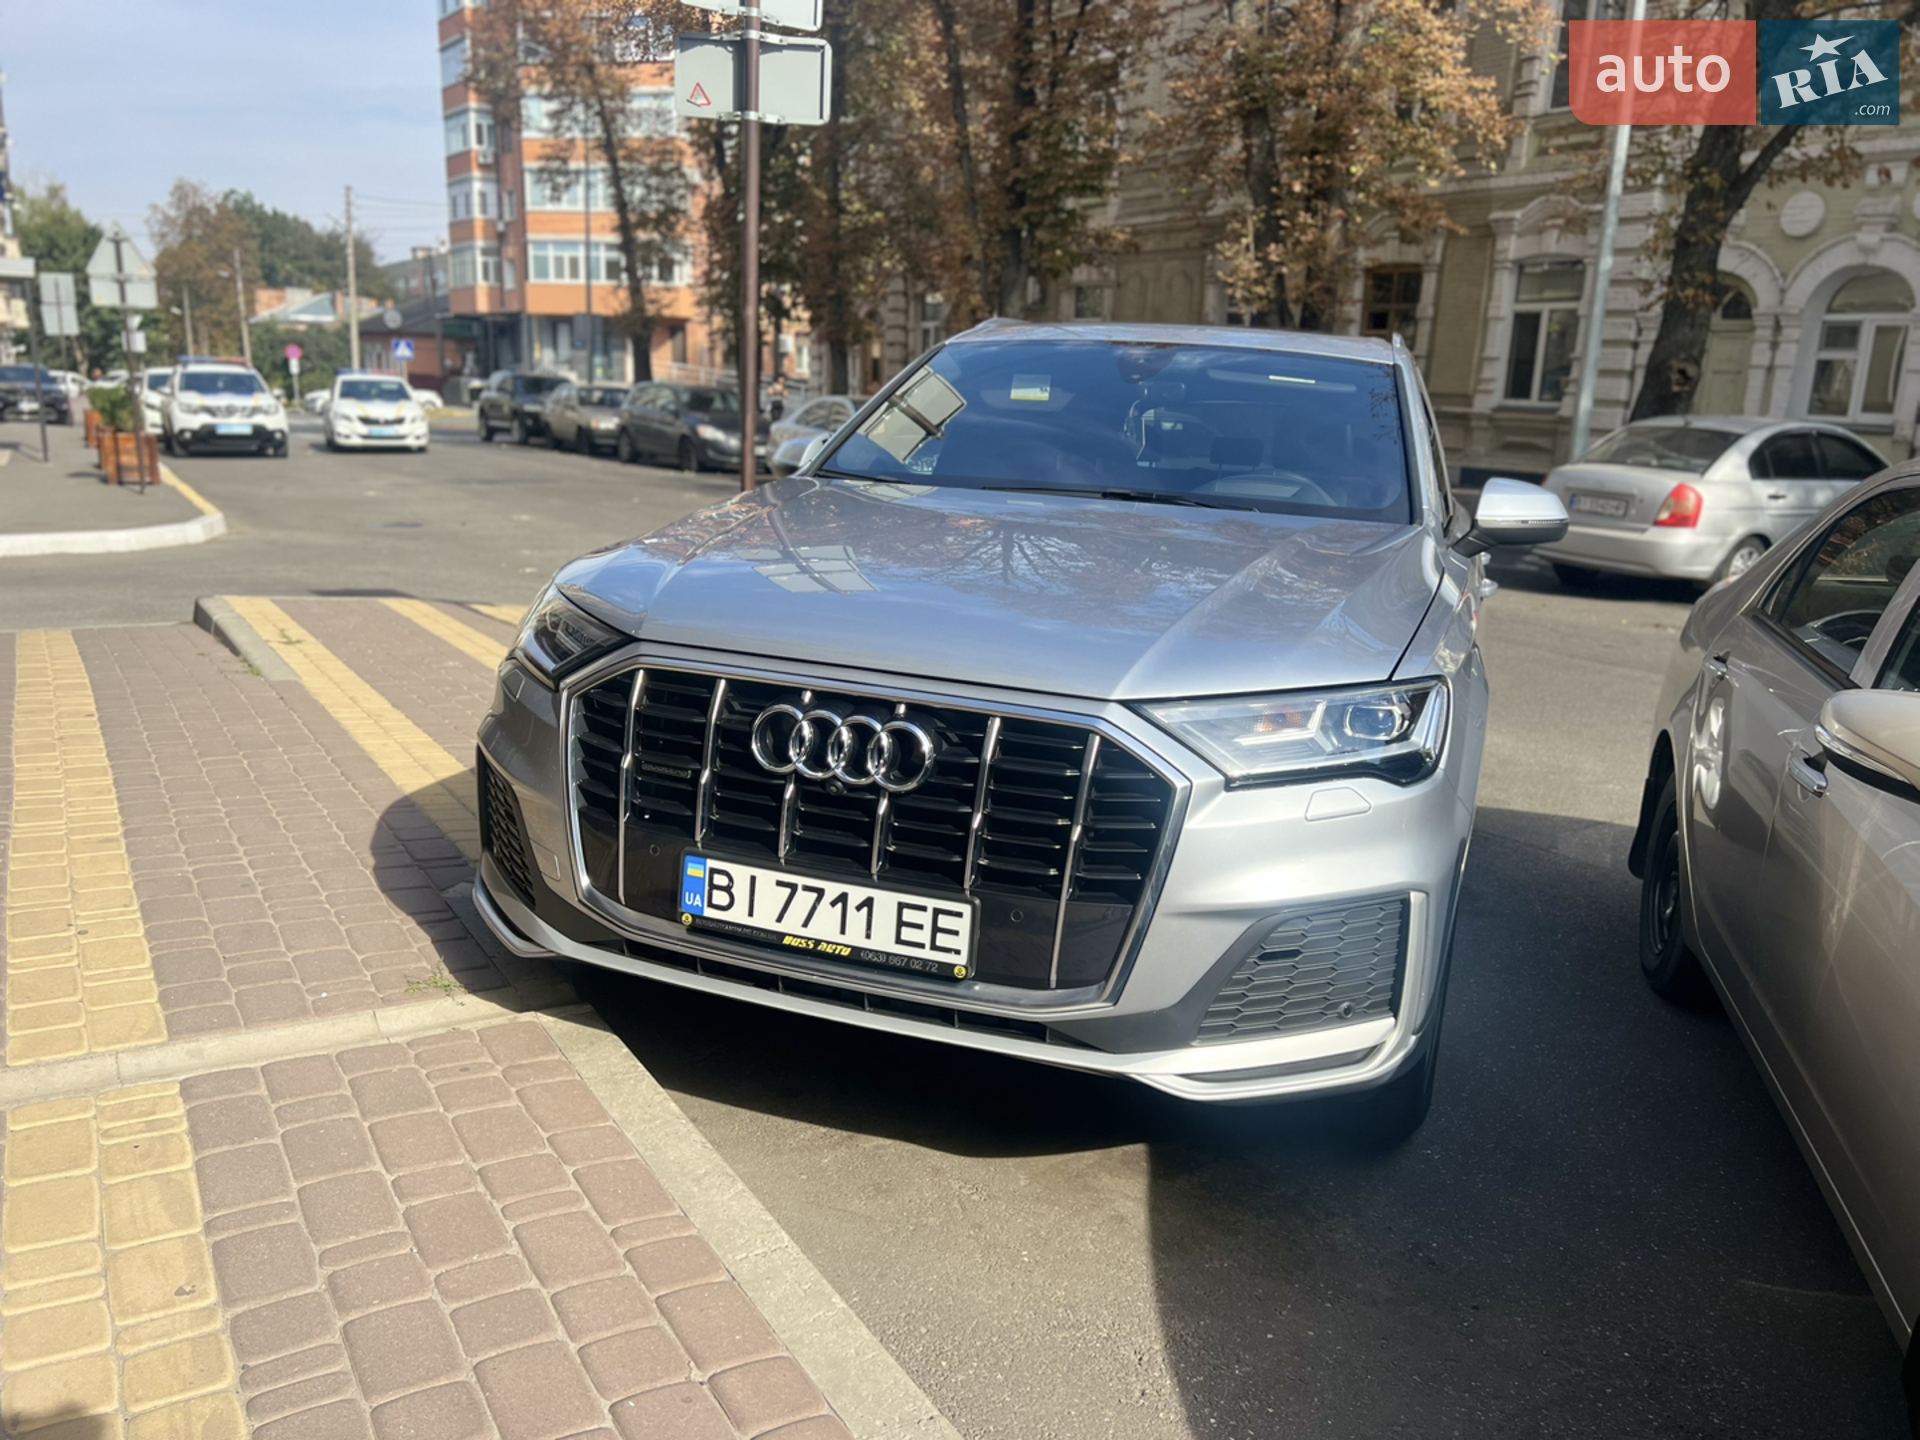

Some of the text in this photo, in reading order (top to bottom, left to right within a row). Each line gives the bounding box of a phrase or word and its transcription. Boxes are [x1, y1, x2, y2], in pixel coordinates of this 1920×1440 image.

[685, 891, 703, 908] UA
[707, 867, 964, 956] BI 7711 EE
[860, 950, 886, 964] (063)
[909, 957, 923, 969] 02
[926, 961, 939, 973] 72
